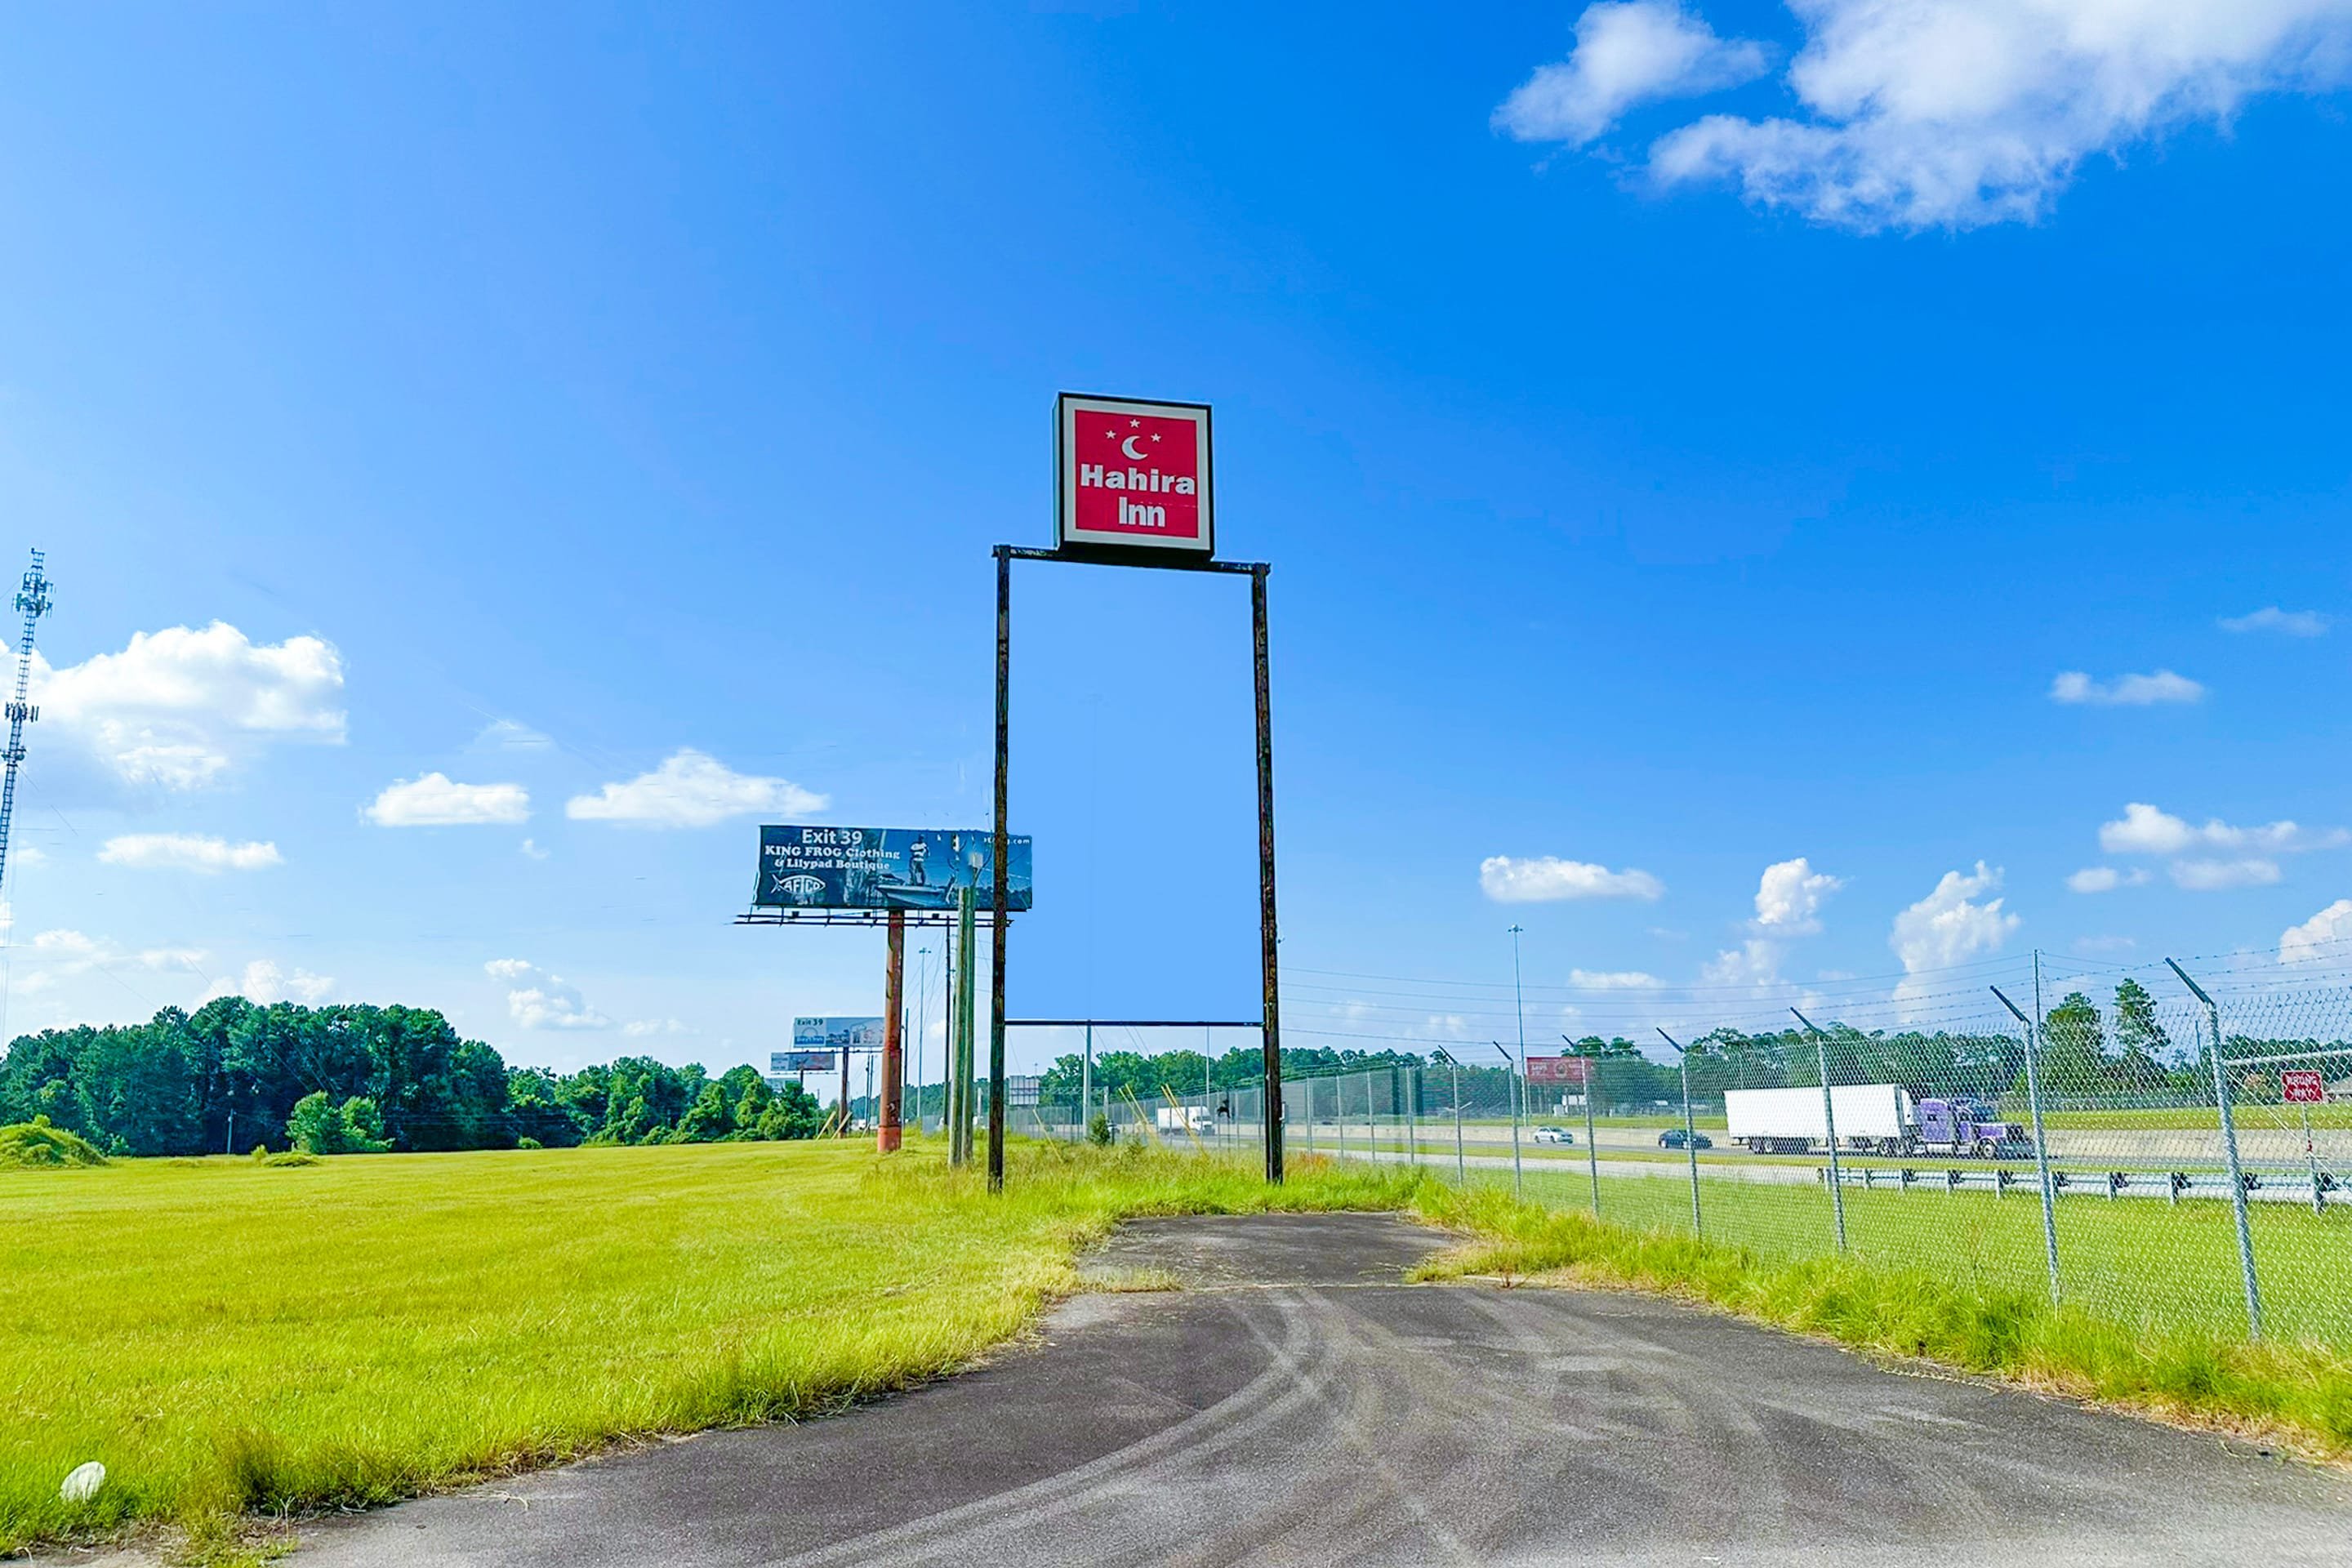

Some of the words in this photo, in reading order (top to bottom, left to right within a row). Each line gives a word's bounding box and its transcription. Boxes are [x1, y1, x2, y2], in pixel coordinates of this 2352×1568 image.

[1080, 464, 1195, 495] Hahira
[1119, 497, 1165, 528] Inn
[802, 829, 836, 844] Exit
[840, 830, 862, 844] 39
[765, 845, 801, 856] KING
[804, 847, 842, 857] FROG
[845, 848, 900, 859] Clothing
[774, 859, 784, 867] &
[786, 858, 832, 870] Lilypad
[836, 860, 889, 871] Boutique
[784, 877, 821, 893] AFTCO
